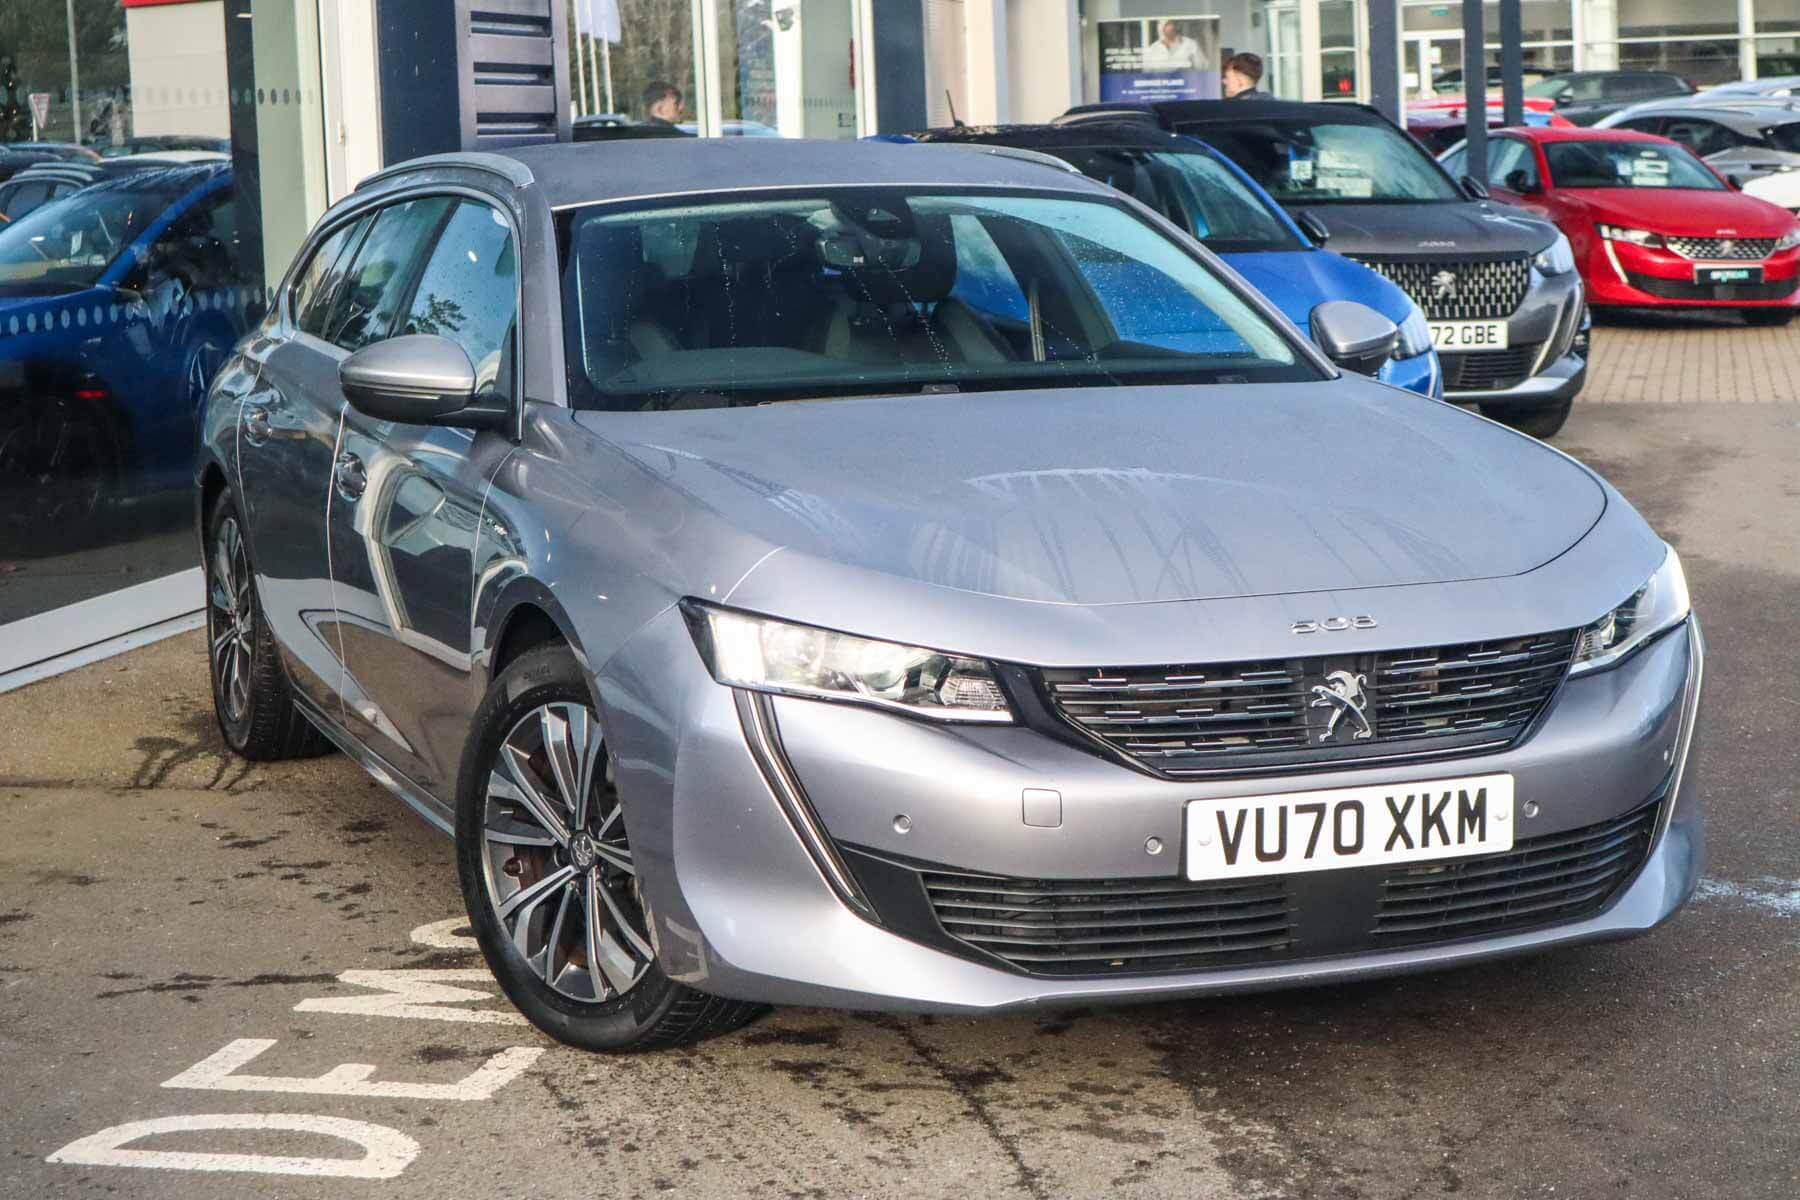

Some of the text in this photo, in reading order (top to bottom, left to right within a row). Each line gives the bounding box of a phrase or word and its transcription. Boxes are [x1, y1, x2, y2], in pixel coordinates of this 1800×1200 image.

[1430, 324, 1498, 345] 72 GBE
[1289, 615, 1377, 634] 508
[1215, 787, 1488, 866] VU70 XKM
